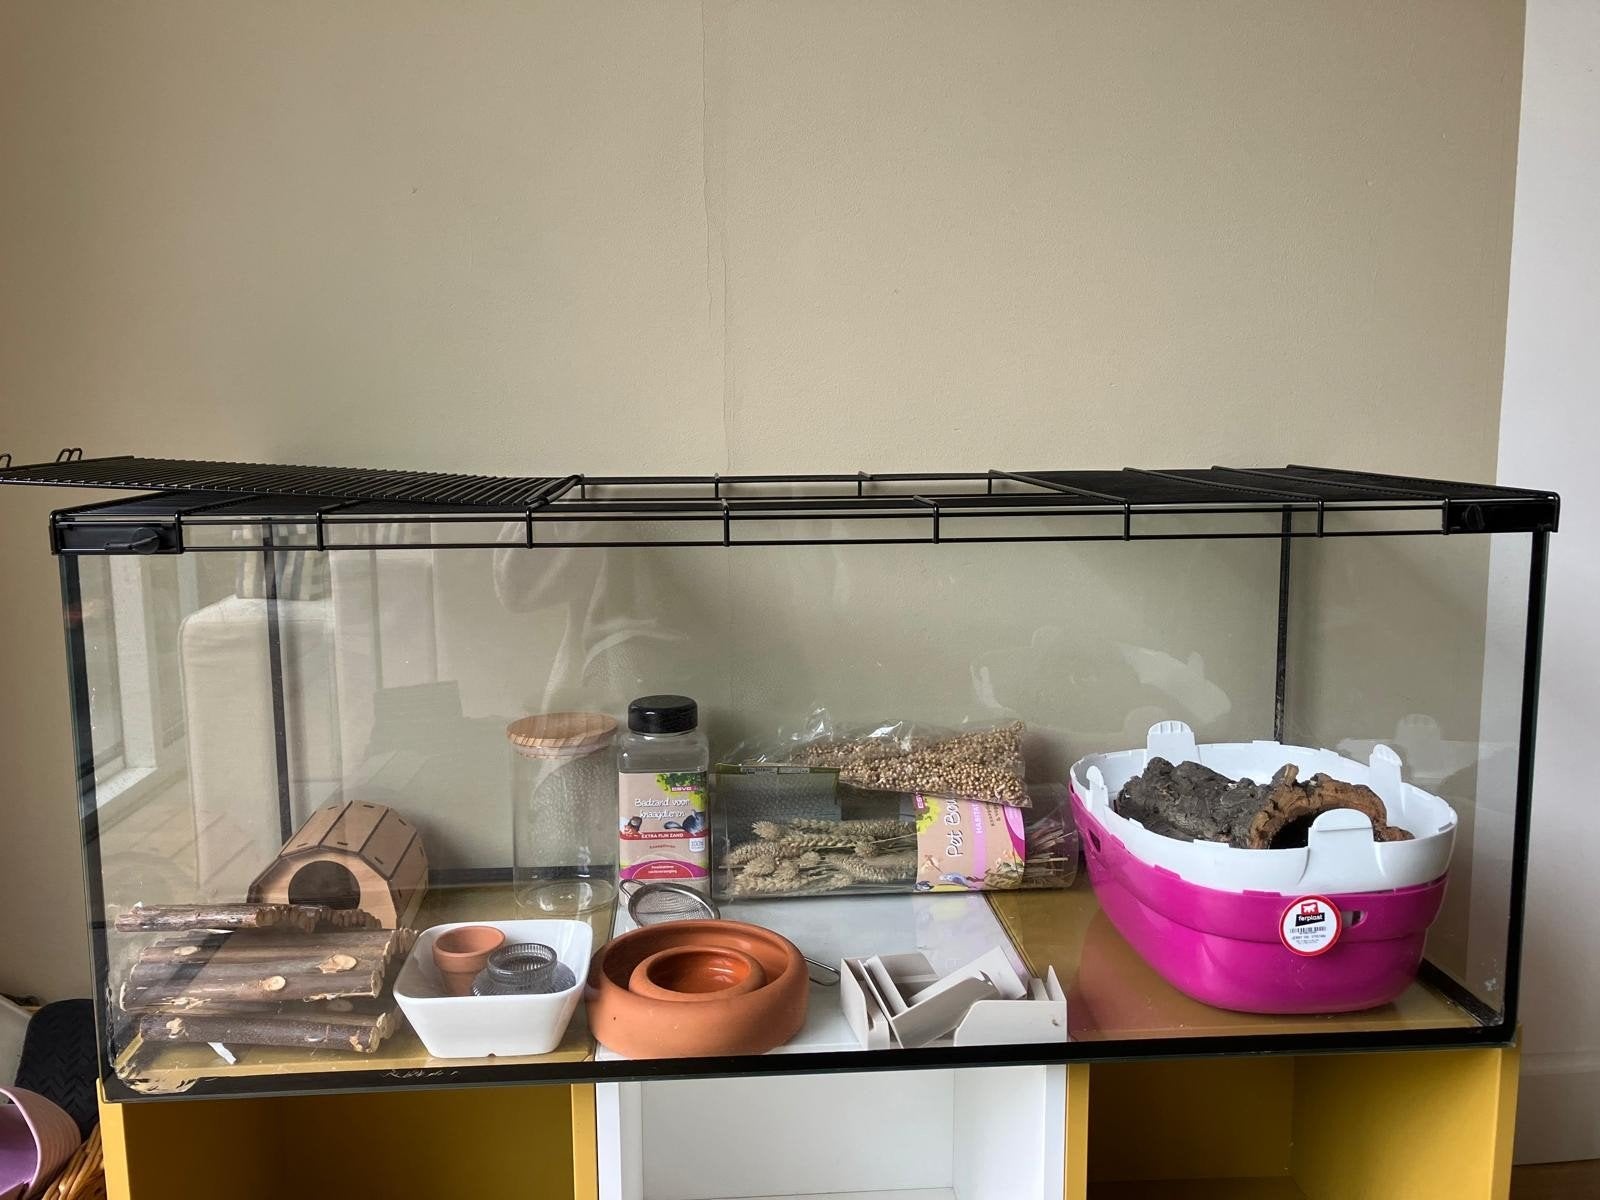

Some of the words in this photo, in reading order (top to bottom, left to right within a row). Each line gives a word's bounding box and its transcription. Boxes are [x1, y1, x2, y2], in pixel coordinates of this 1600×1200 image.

[634, 797, 669, 806] Badzand
[943, 799, 961, 826] Bou
[945, 829, 964, 857] Pet
[1298, 914, 1323, 922] ferplast
